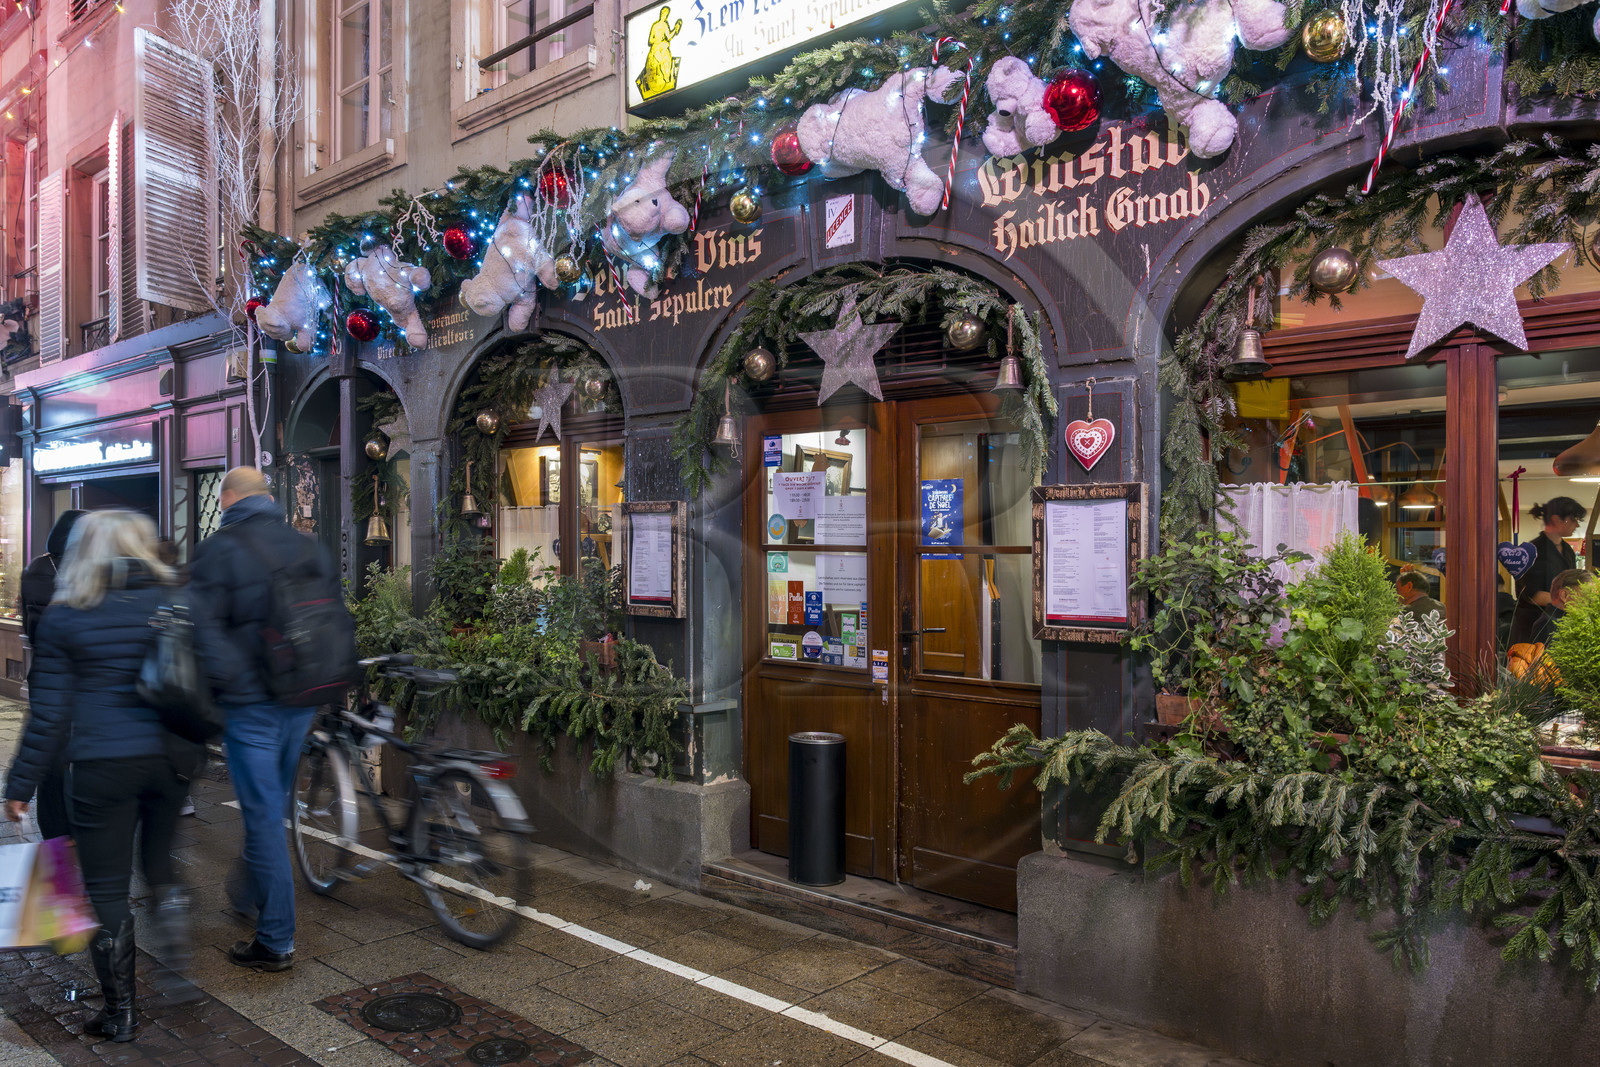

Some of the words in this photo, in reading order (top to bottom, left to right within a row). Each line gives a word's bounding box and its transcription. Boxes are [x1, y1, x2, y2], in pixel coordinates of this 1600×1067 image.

[977, 112, 1190, 208] Winstub
[827, 199, 853, 243] LICENCE
[992, 193, 1101, 262] Hailich
[1106, 168, 1210, 233] Graab
[694, 228, 764, 274] Vins
